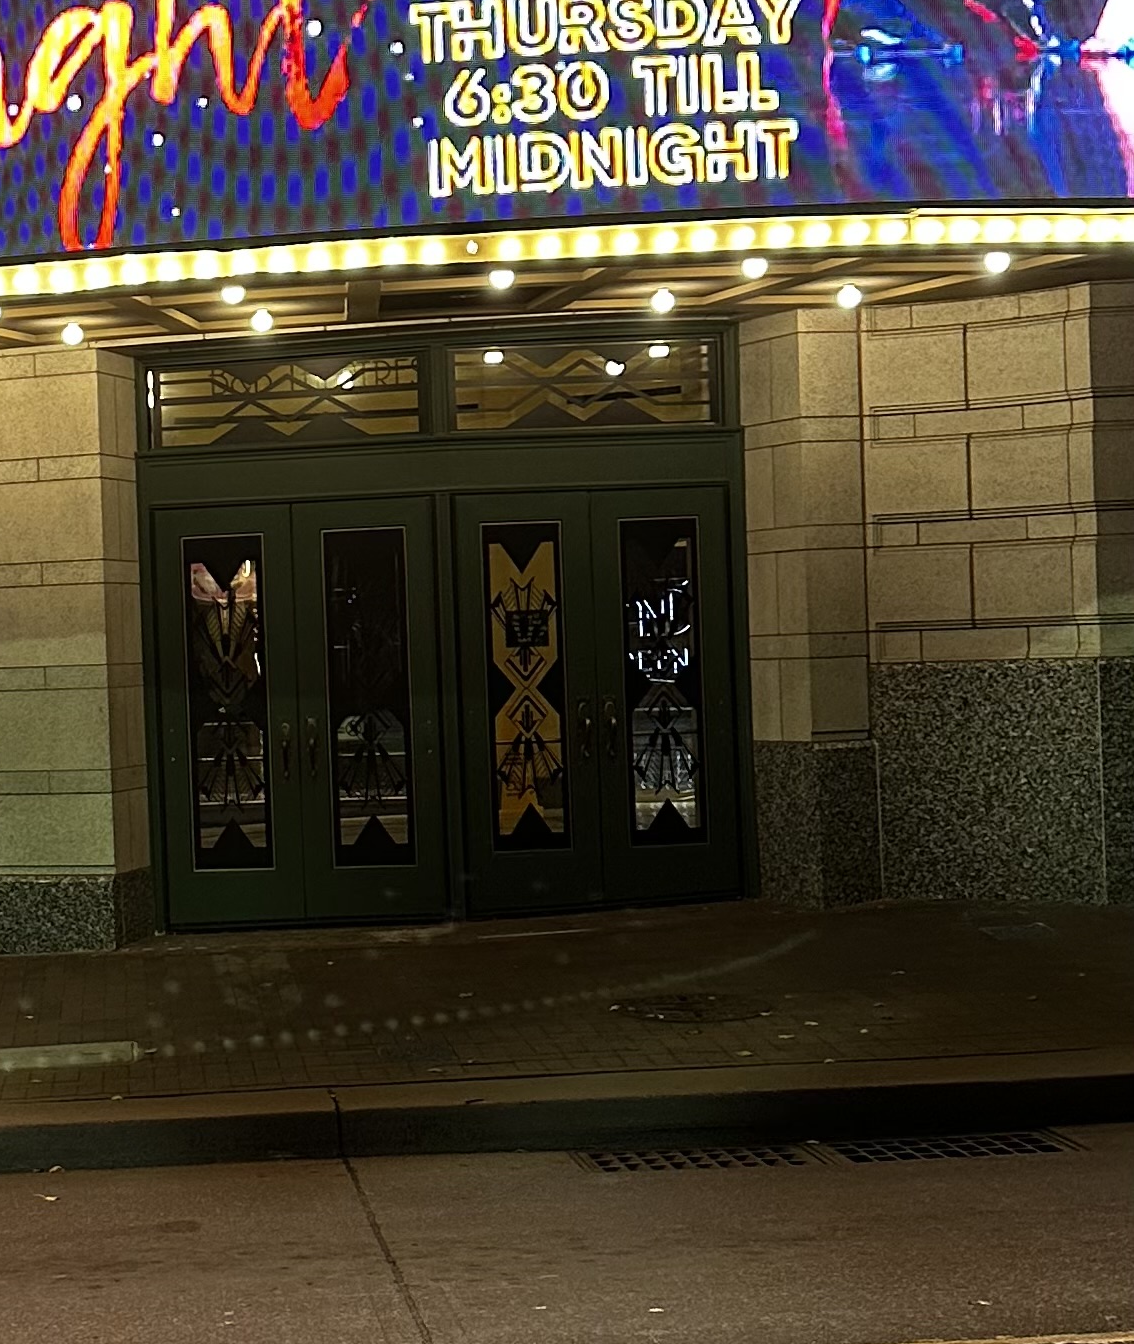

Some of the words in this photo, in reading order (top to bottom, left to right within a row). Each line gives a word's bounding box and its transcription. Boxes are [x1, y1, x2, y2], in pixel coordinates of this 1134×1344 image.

[443, 60, 610, 126] 6:30
[632, 53, 781, 118] TILL
[428, 119, 800, 199] MIDNIGHT
